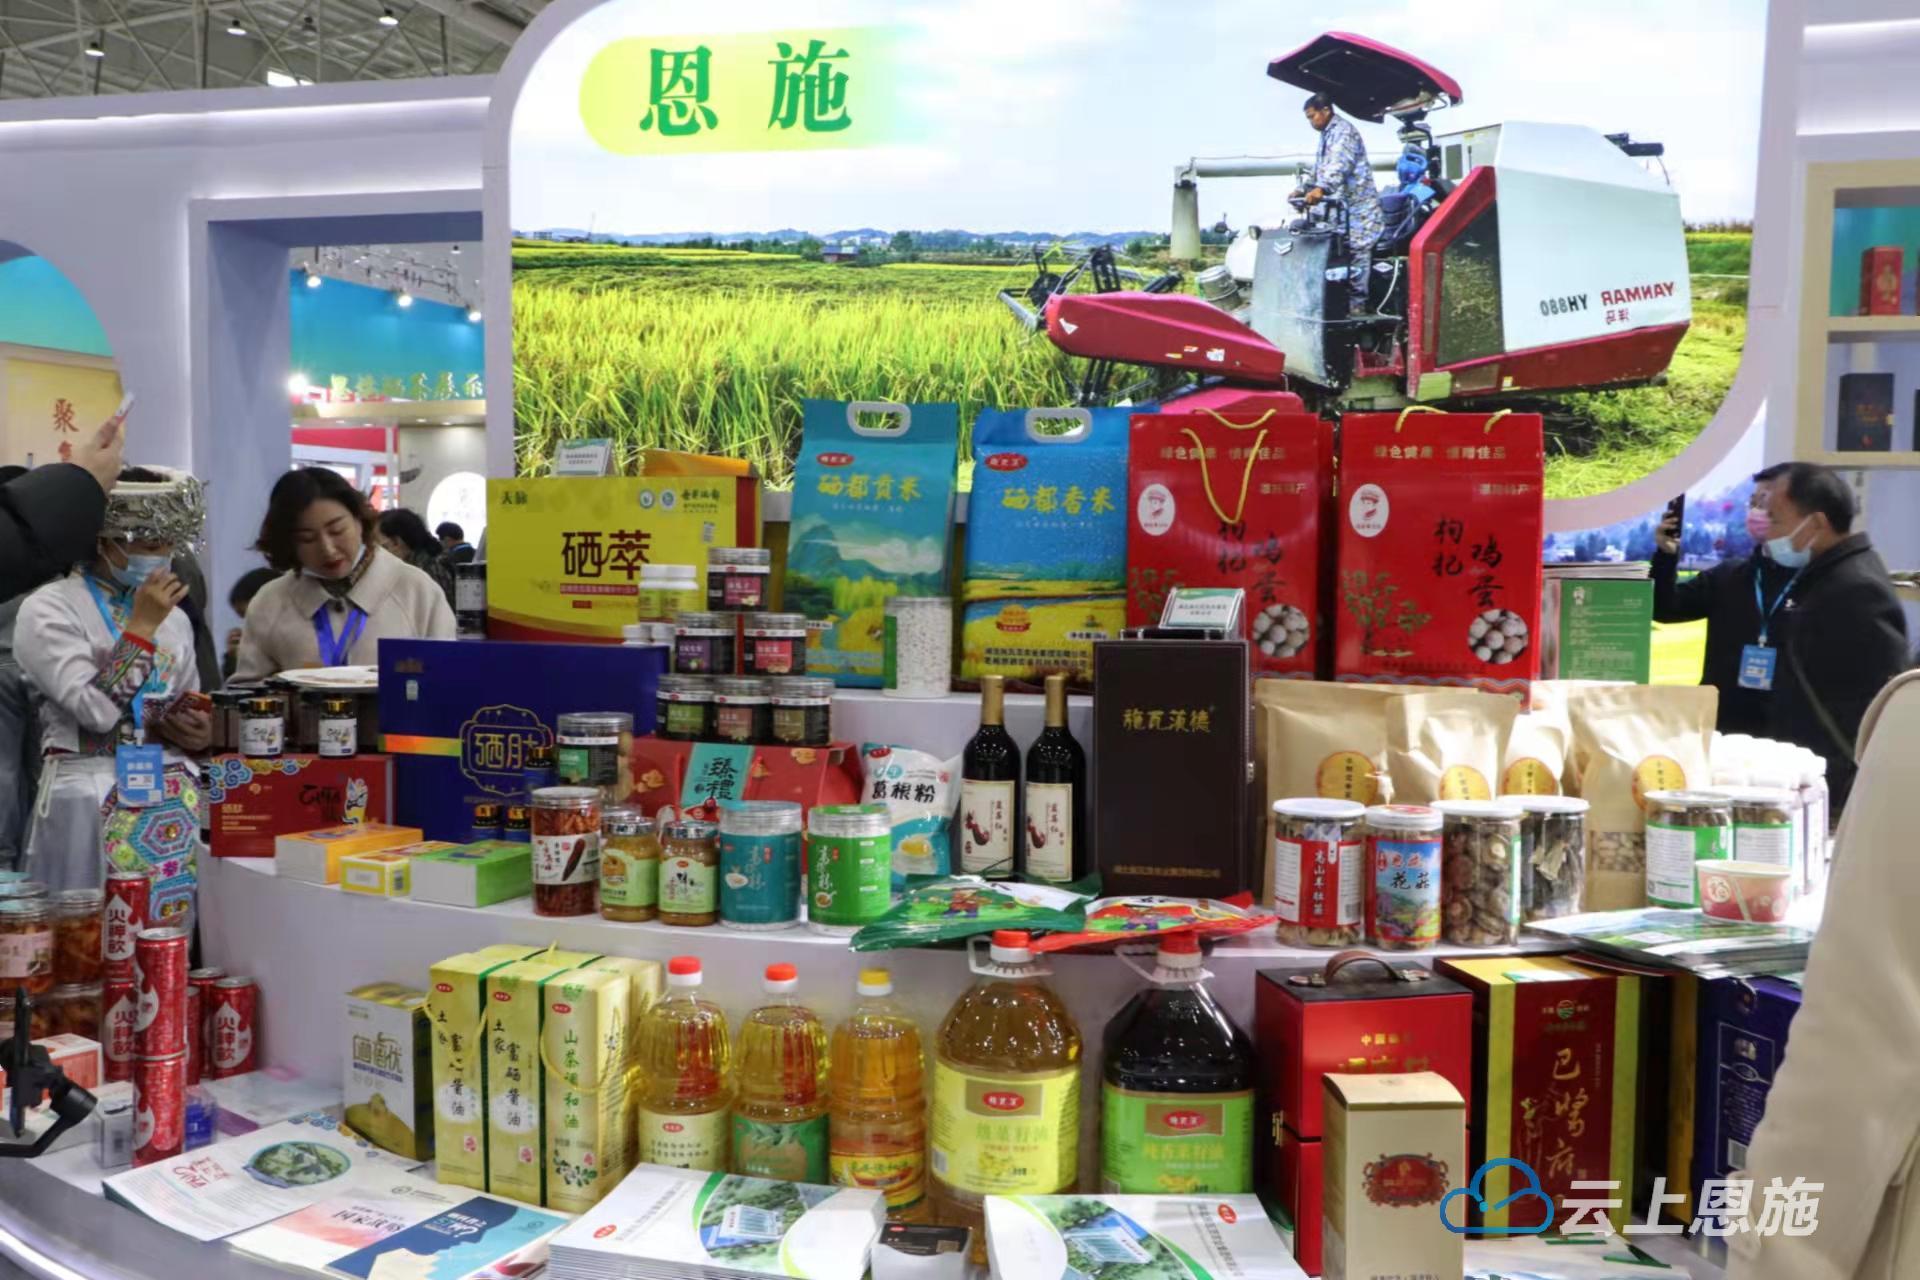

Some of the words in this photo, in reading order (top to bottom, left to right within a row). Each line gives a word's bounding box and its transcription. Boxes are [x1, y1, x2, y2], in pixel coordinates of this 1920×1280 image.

[639, 40, 852, 136] 恩施
[872, 780, 936, 804] 葛根粉
